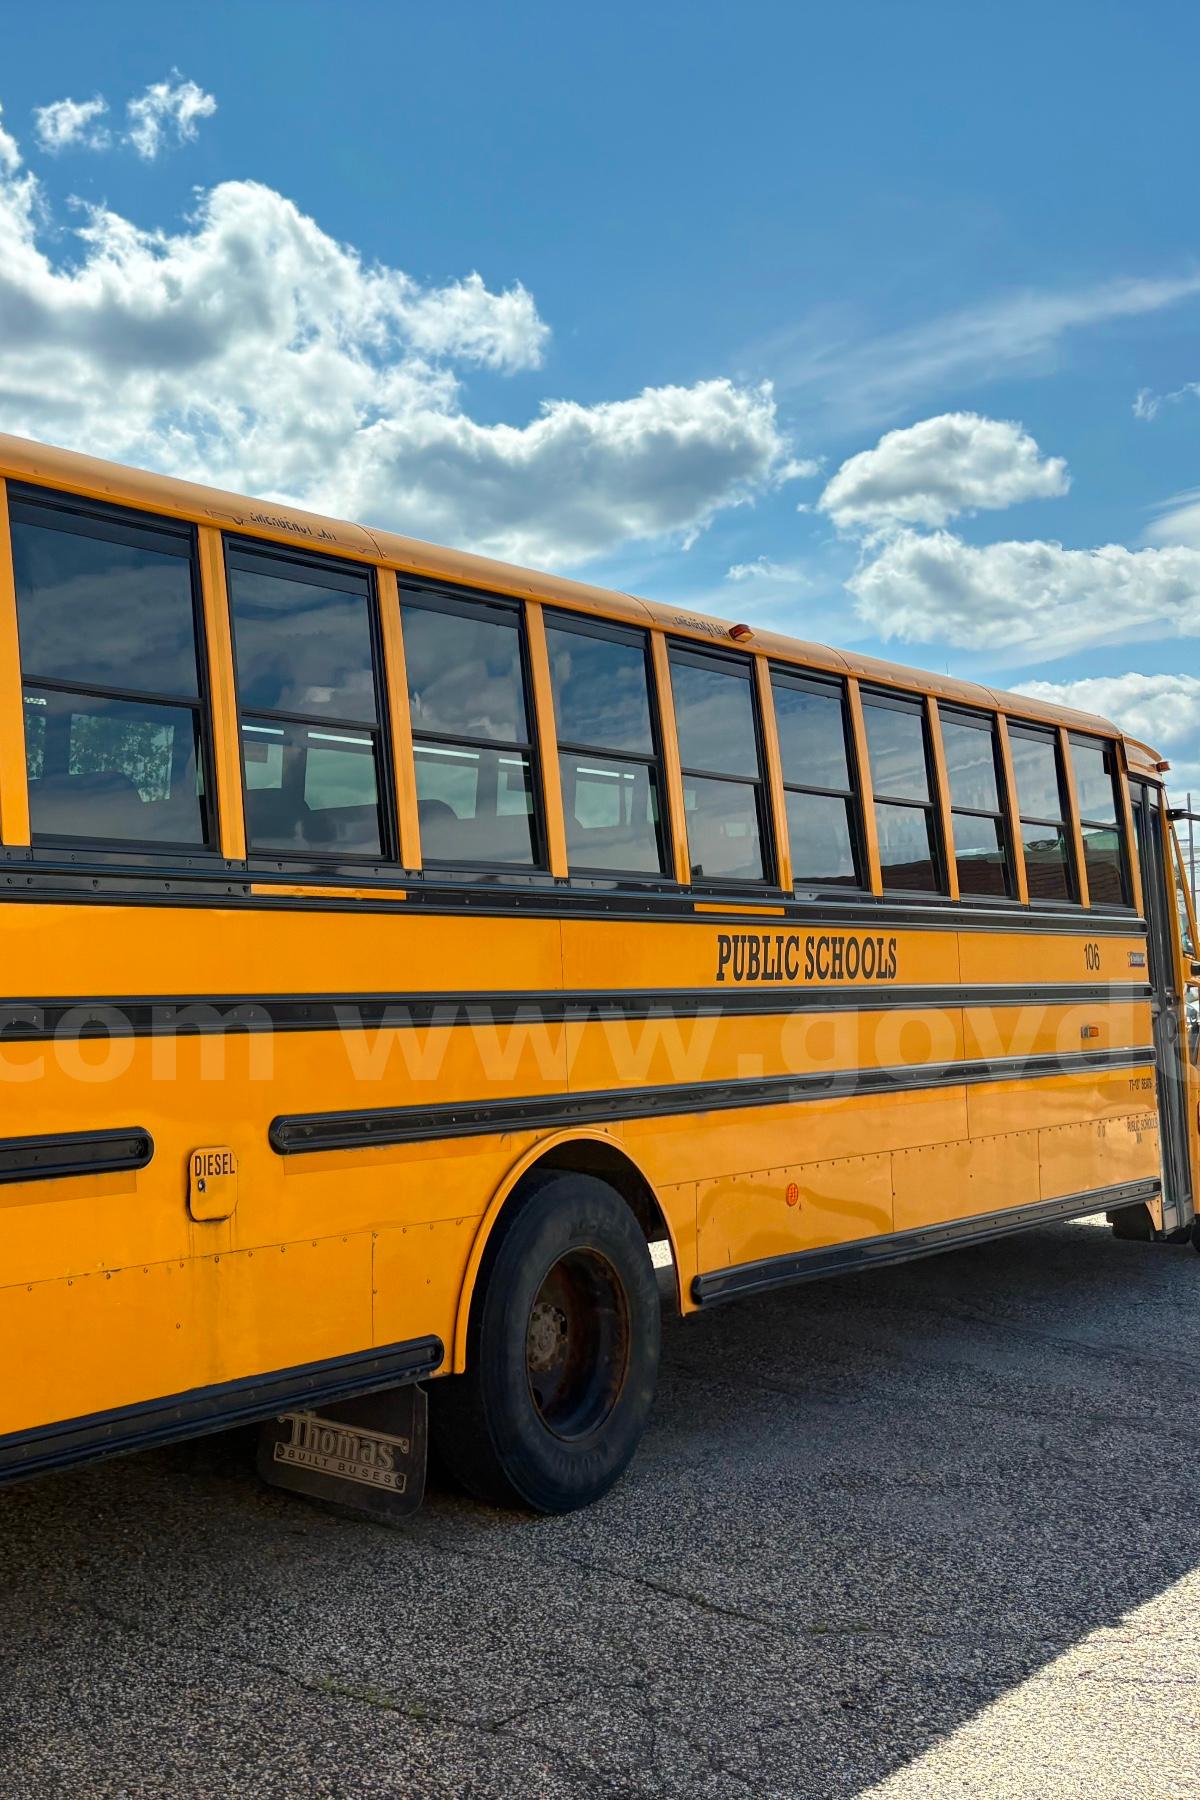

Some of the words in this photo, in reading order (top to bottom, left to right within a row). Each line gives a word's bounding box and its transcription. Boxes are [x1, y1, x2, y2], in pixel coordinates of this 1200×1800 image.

[716, 935, 799, 981] PUBLIC
[804, 936, 897, 980] SCHOOLS
[1084, 943, 1100, 971] 106
[195, 1153, 236, 1177] DIESEL
[284, 1410, 398, 1472] Thomas
[288, 1450, 329, 1467] BUILT
[337, 1463, 392, 1485] BUSES
